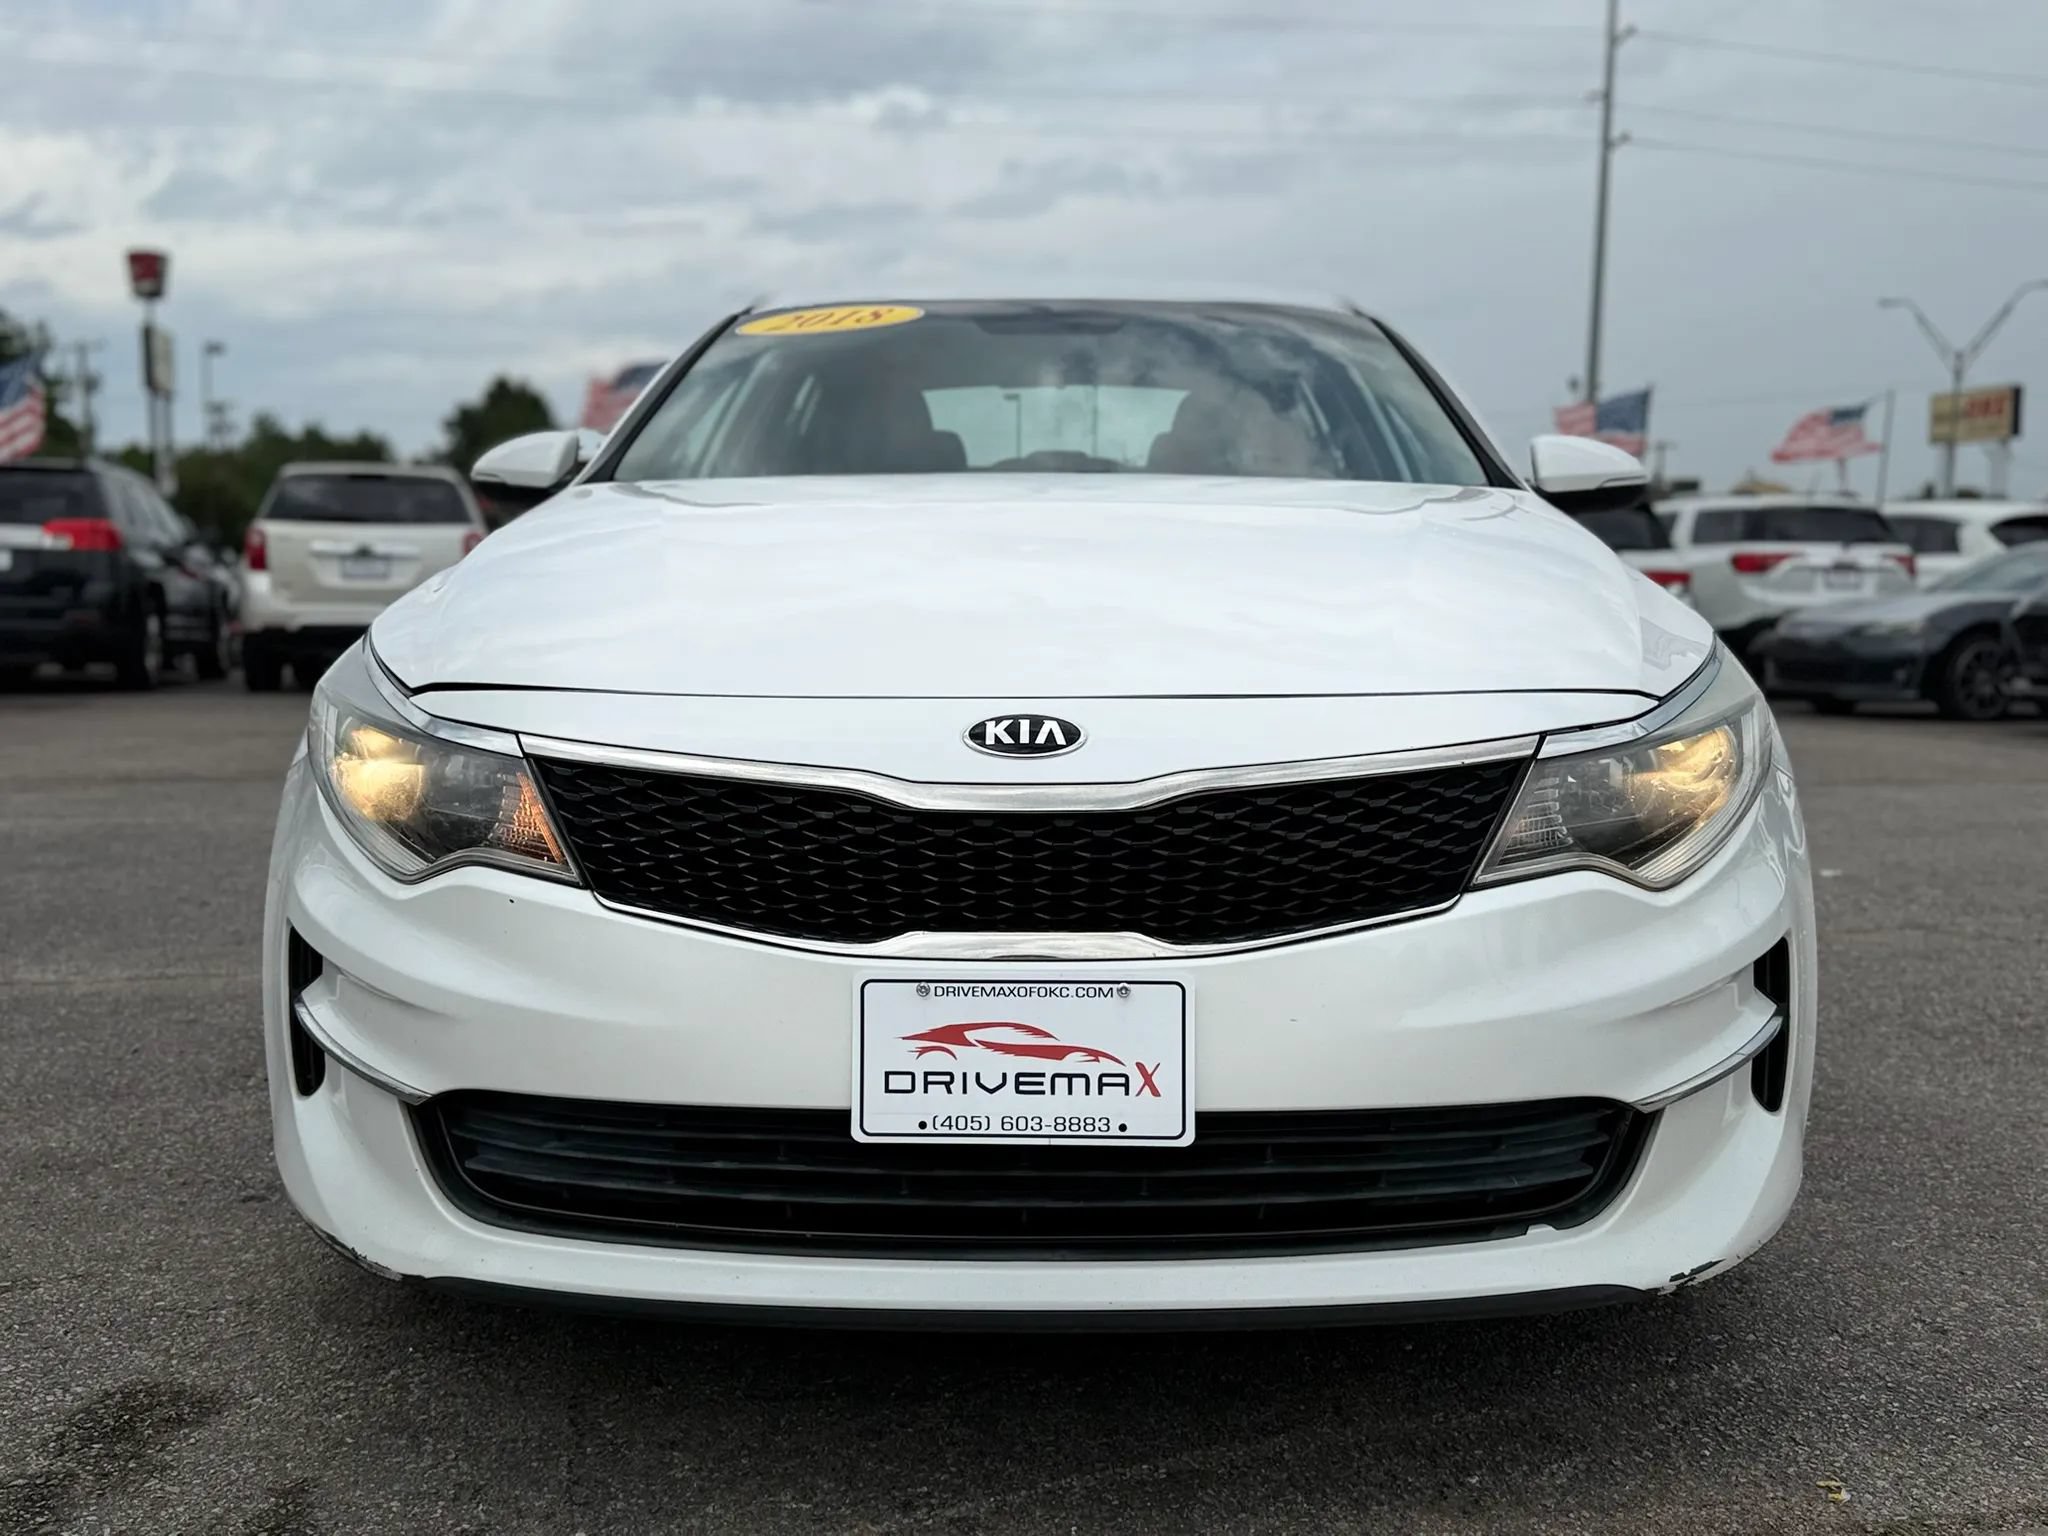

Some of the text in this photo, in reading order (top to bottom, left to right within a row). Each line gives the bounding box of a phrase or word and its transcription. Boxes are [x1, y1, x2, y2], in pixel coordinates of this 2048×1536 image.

[764, 308, 895, 332] 2018
[984, 719, 1067, 746] KIA
[934, 985, 1114, 999] DRIVEMAXOFOKC.COM
[884, 1062, 1161, 1097] DRIVEMAX
[932, 1115, 1111, 1133] (405) 603-8883
